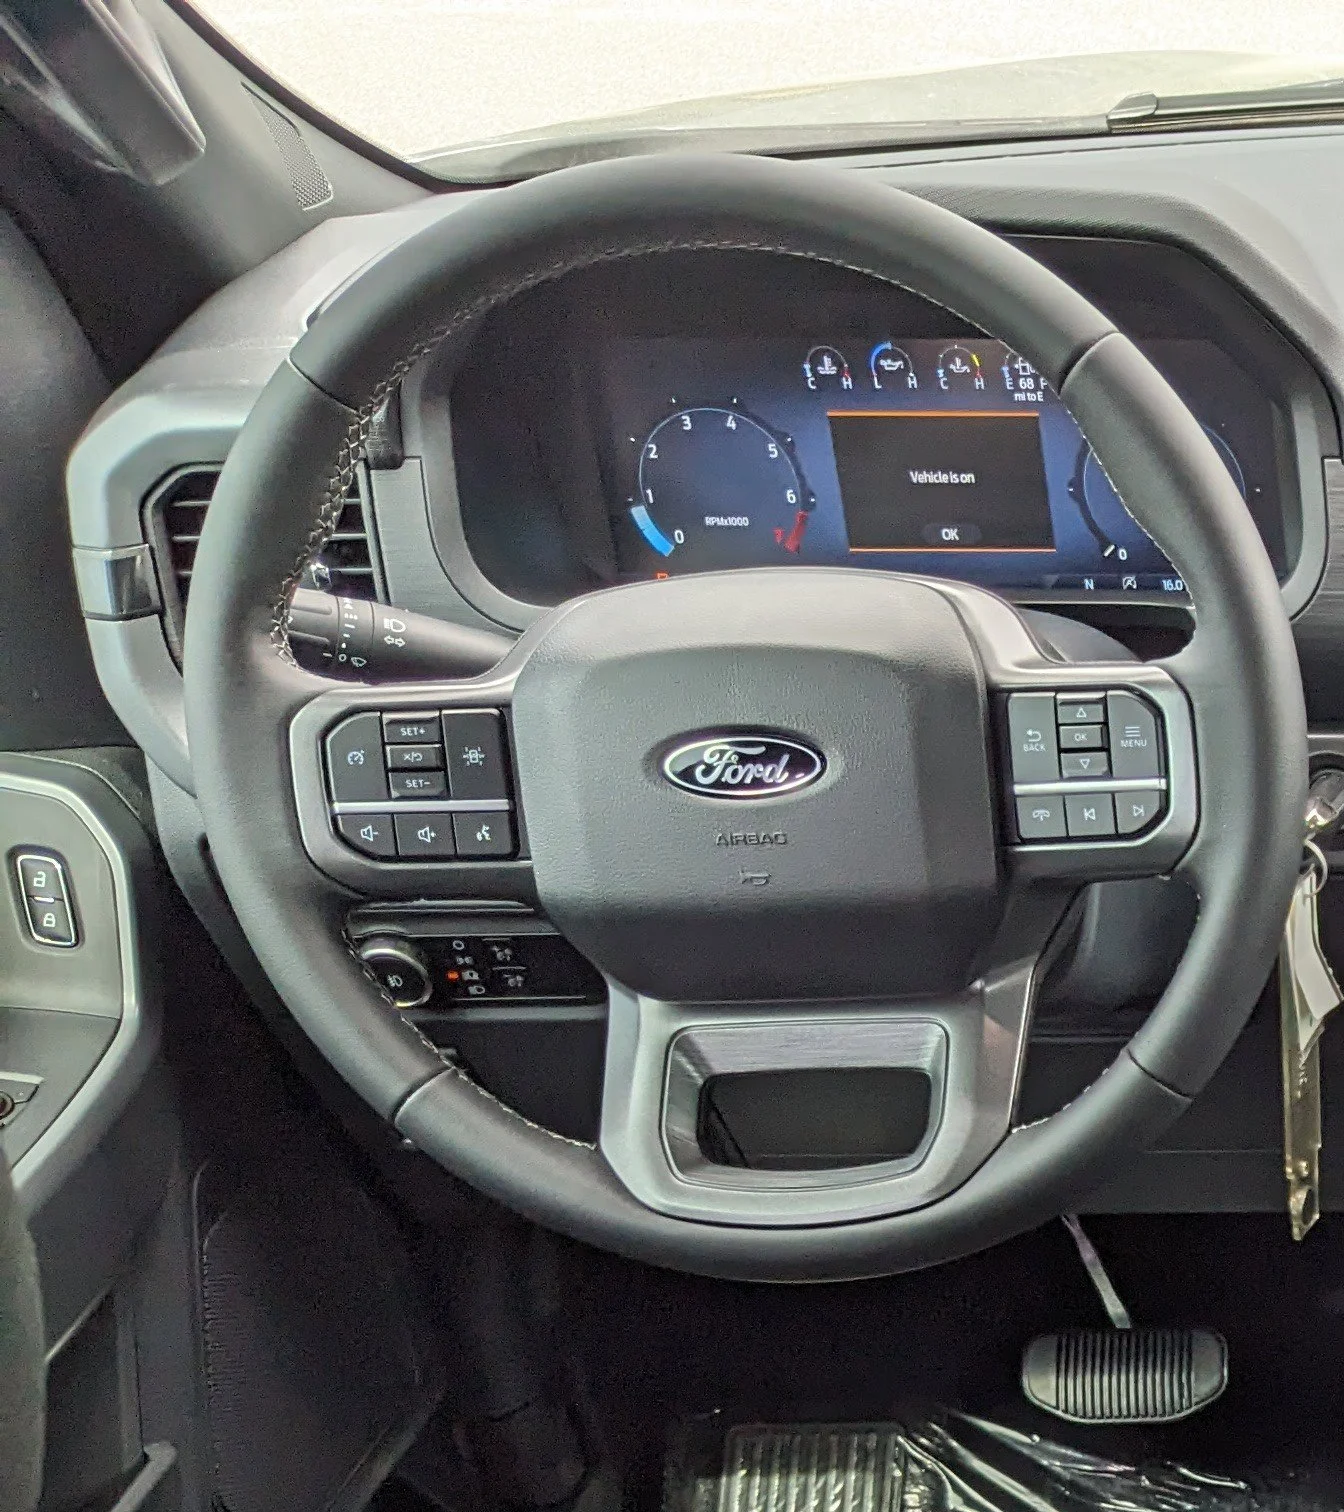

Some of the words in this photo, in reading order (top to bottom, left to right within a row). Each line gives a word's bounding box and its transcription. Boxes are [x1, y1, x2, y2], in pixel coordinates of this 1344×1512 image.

[807, 378, 816, 389] C
[842, 378, 852, 389] H
[874, 378, 881, 389] L
[907, 377, 917, 389] H
[940, 378, 948, 389] C
[975, 378, 984, 390] H
[1006, 378, 1014, 390] E
[1019, 378, 1034, 390] 68
[1037, 392, 1044, 402] E
[681, 416, 692, 430] 3
[726, 416, 737, 431] 4
[647, 445, 659, 459] 2
[768, 445, 779, 458] 5
[910, 471, 948, 484] Vehicle
[950, 472, 959, 483] is
[960, 473, 976, 484] on
[645, 489, 654, 504] 1
[786, 490, 796, 504] 6
[705, 516, 749, 527] RPMx1000
[674, 529, 684, 544] 0
[942, 528, 960, 540] OK
[1118, 549, 1127, 561] 0
[1084, 578, 1094, 590] N
[1023, 744, 1046, 752] BACK
[1120, 740, 1147, 748] MENU
[695, 745, 789, 785] Ford
[715, 833, 788, 847] AIRBAG
